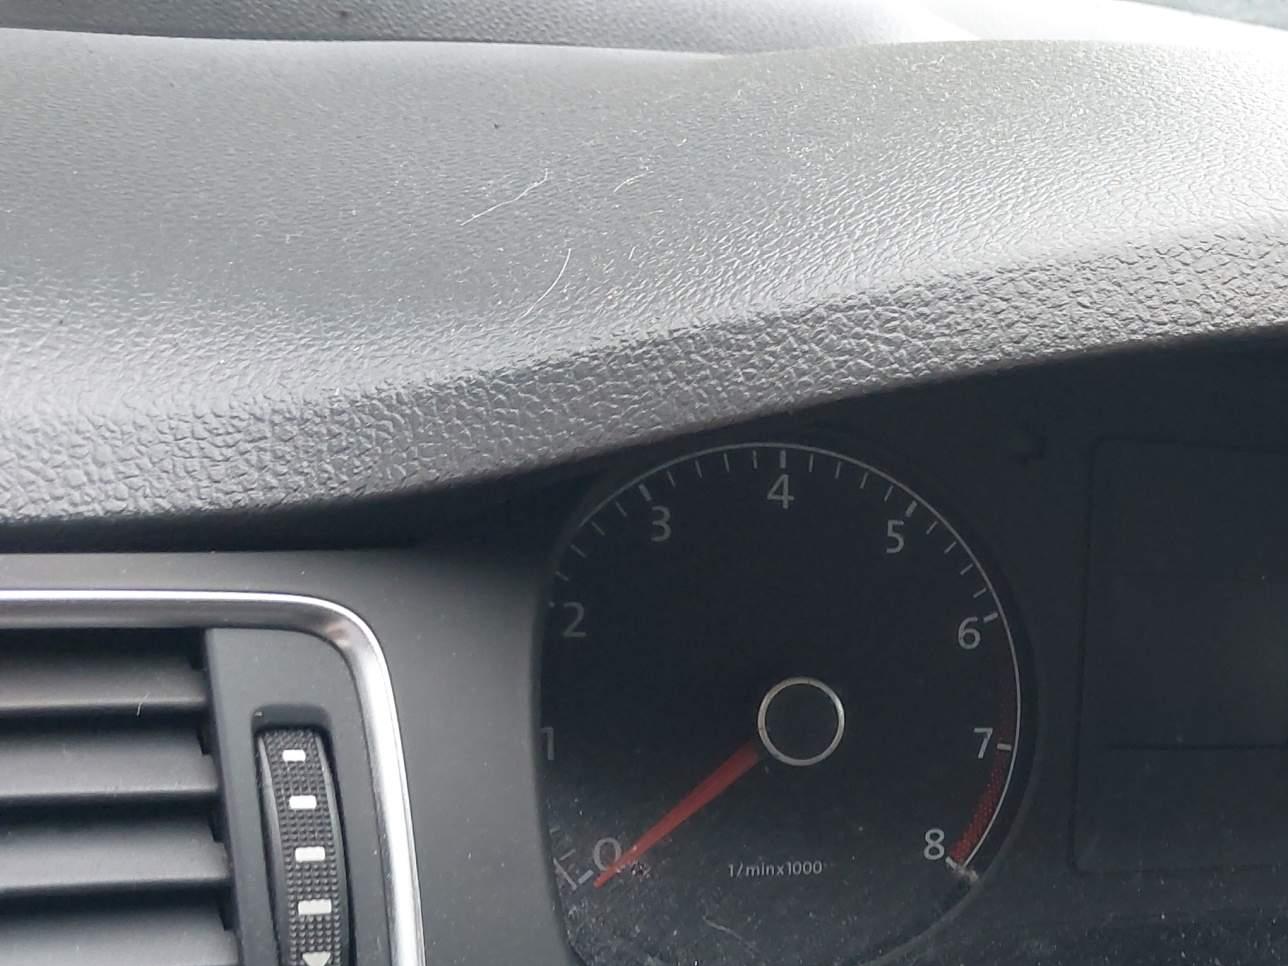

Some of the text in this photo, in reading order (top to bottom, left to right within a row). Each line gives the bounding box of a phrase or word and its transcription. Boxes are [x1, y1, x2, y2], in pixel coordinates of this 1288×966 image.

[766, 473, 795, 510] 4
[651, 505, 672, 542] 3
[886, 519, 905, 553] 5
[562, 601, 587, 639] 2
[958, 617, 981, 650] 6
[541, 727, 554, 760] 1
[974, 727, 994, 760] 7
[593, 837, 622, 871] 0
[924, 828, 945, 861] 8
